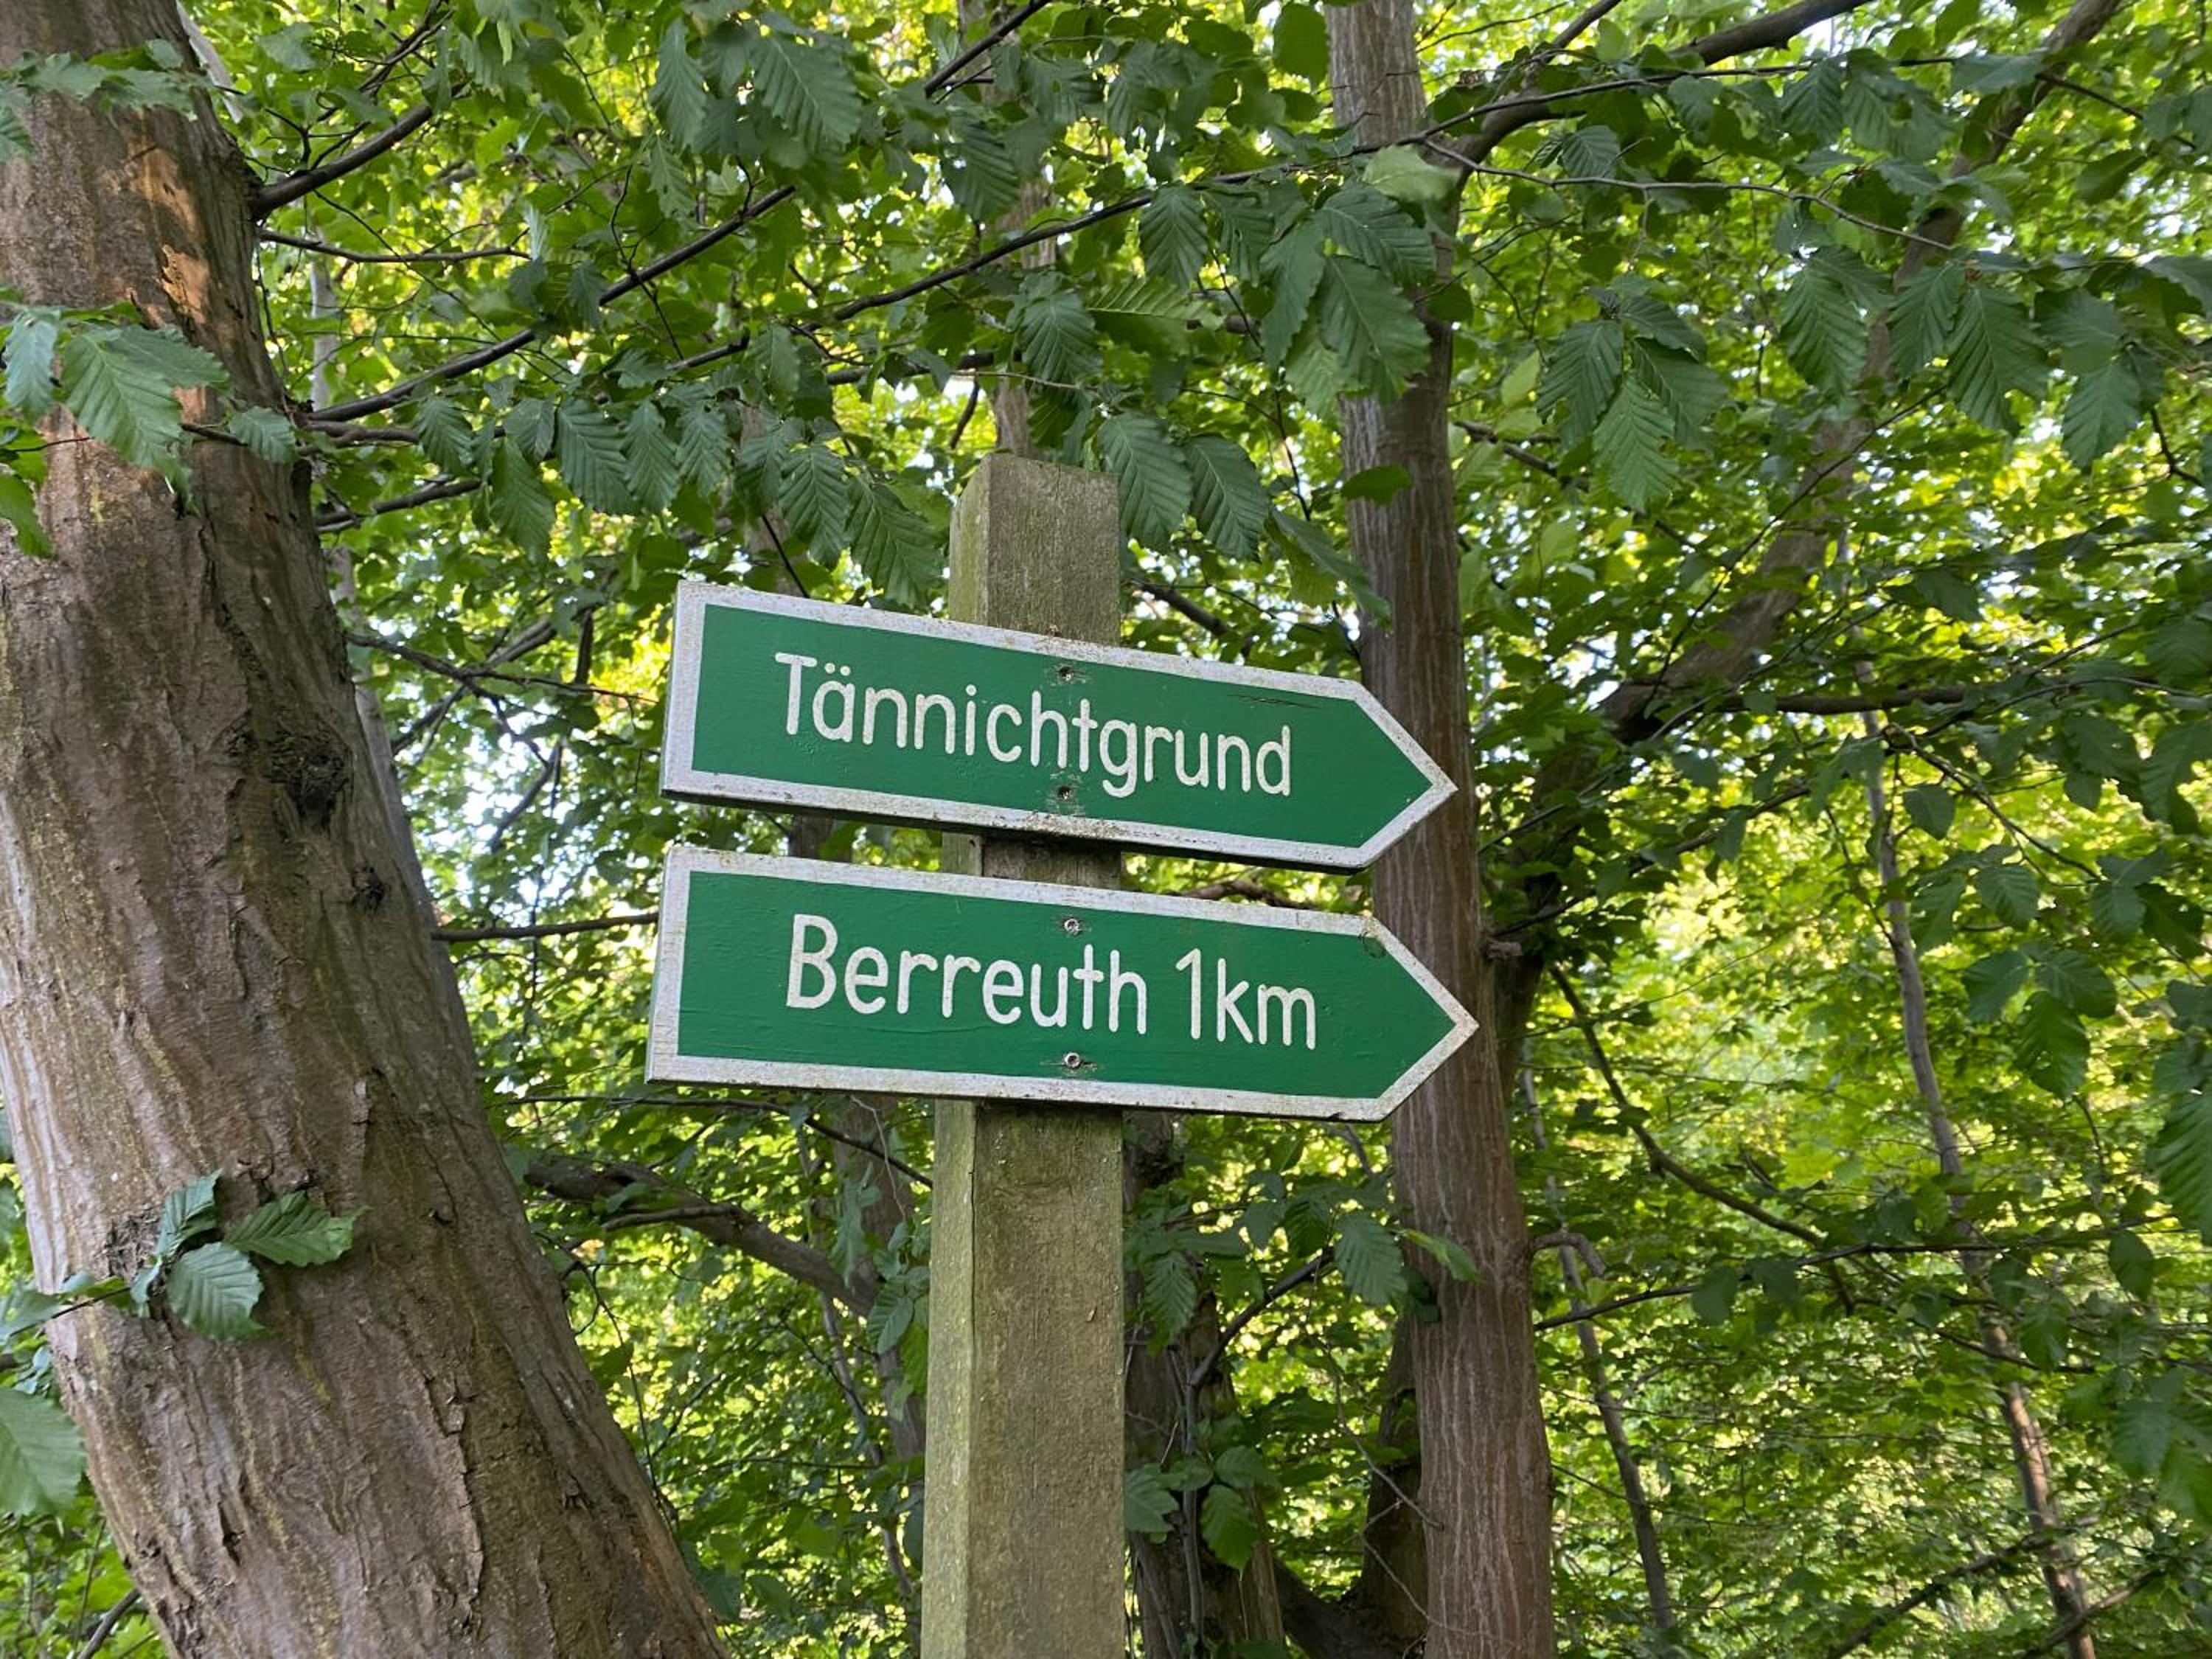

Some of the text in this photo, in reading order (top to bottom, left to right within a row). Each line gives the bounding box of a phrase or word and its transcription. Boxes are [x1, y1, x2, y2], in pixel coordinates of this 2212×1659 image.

[773, 651, 1292, 799] Tännichtgrund
[785, 914, 1317, 1051] Berreuth 1km
